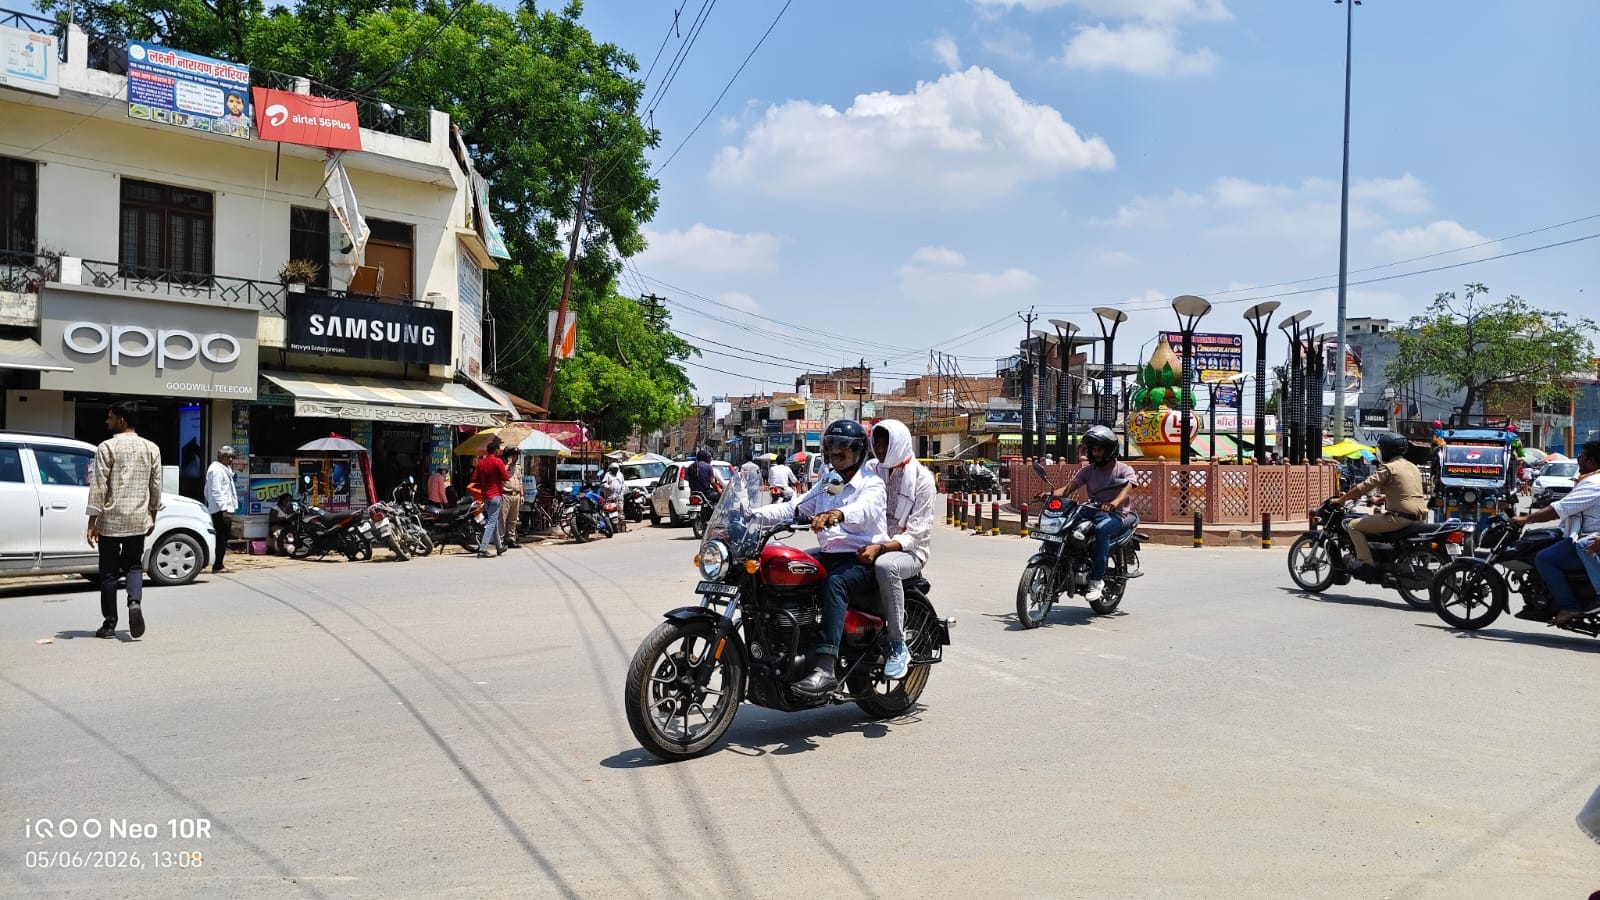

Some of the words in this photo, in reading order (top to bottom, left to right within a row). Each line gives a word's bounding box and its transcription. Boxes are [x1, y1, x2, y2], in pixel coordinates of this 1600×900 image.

[148, 50, 176, 67] लक्ष्मी
[177, 57, 212, 75] नारायण
[214, 64, 249, 82] इंटीरियर
[292, 114, 317, 126] airtel
[309, 314, 436, 346] SAMSUNG
[63, 321, 241, 368] oppo
[166, 382, 212, 393] GOODWILL
[214, 384, 253, 394] TELECOM
[1364, 430, 1385, 442] viv
